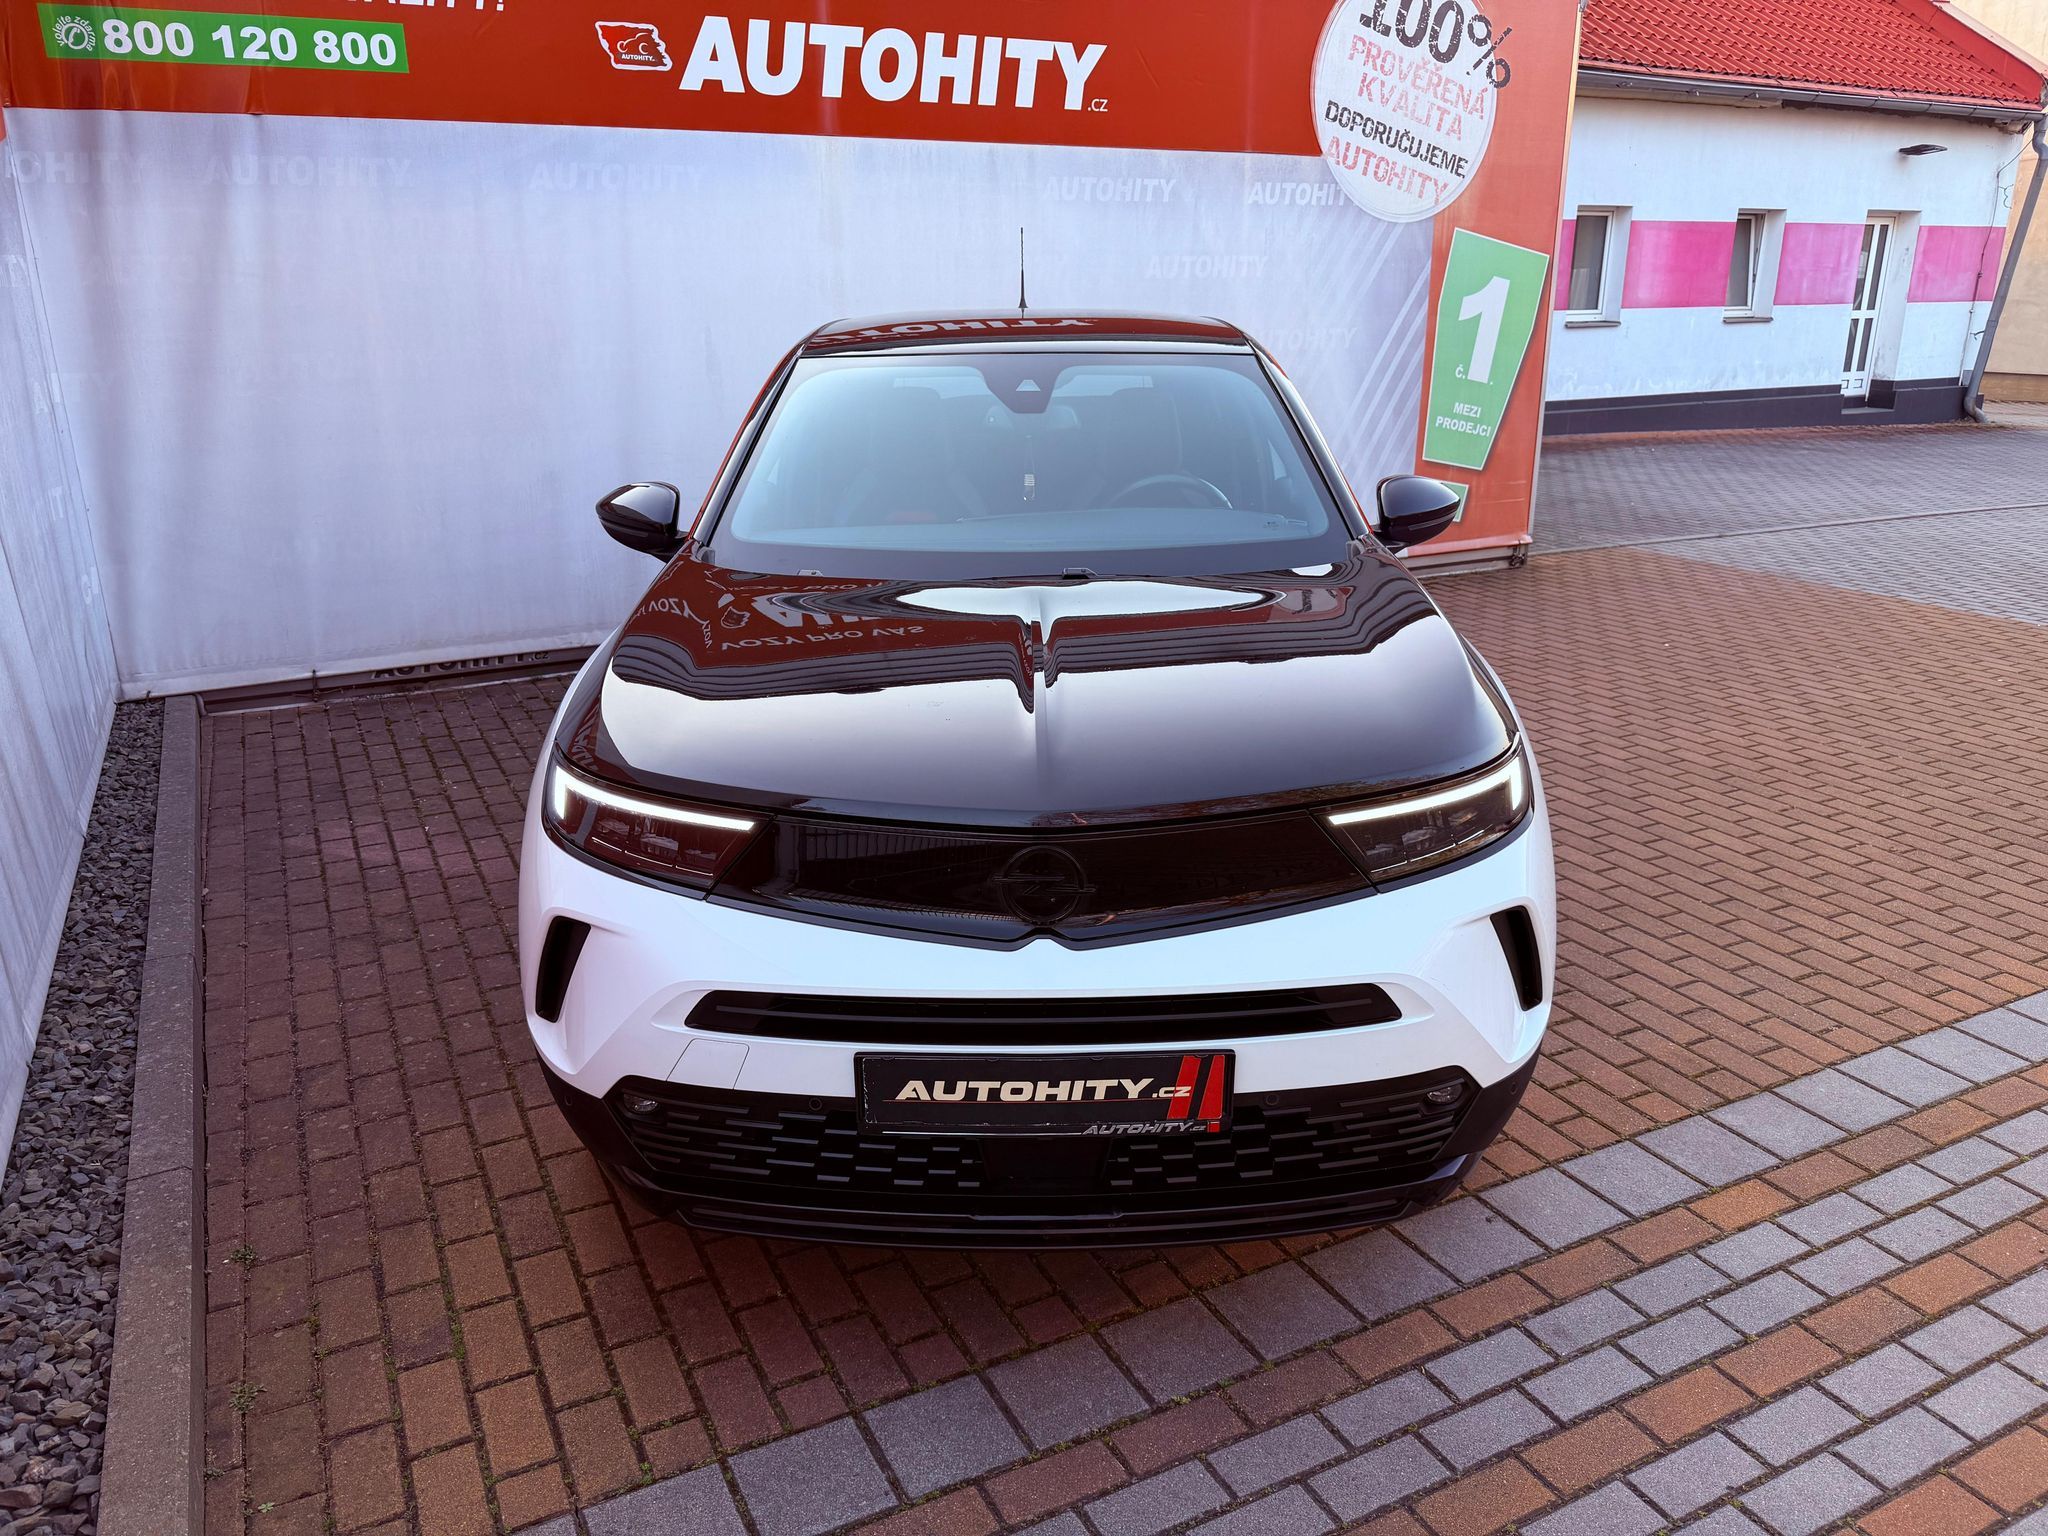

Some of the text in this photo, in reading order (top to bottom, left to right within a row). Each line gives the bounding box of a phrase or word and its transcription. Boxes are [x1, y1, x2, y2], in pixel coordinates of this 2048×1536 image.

[52, 15, 96, 52] volejte zdarma
[102, 19, 397, 66] 800 120 800
[1360, 0, 1512, 88] 100%
[1347, 34, 1489, 120] PROVĚŘENÁ
[1357, 72, 1463, 141] KVALITA
[1324, 100, 1469, 178] DOPORUČUJEME
[1041, 176, 1177, 202] AUTOHITY
[1326, 136, 1449, 205] AUTOHITY
[1246, 181, 1354, 206] AUTOHIT
[1144, 256, 1269, 279] AUTOHITY
[1435, 416, 1492, 437] PRODEJCI
[1453, 402, 1482, 418] MEZI
